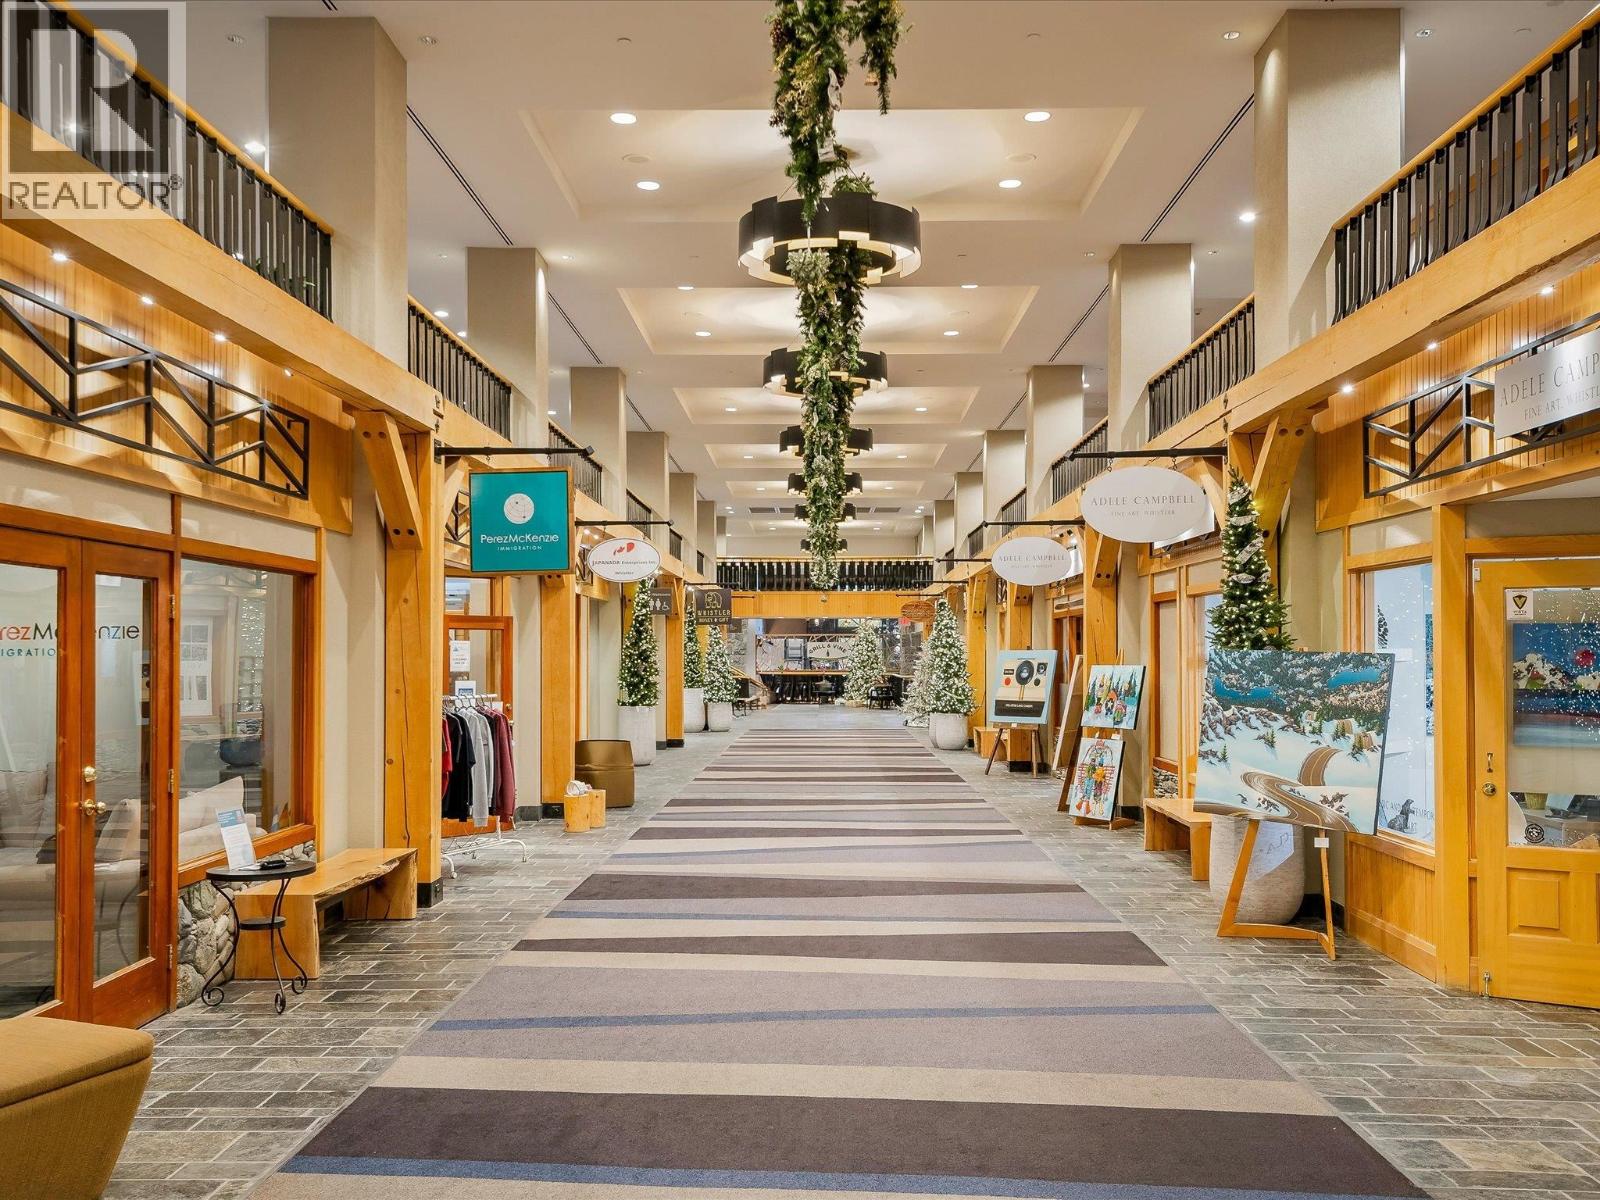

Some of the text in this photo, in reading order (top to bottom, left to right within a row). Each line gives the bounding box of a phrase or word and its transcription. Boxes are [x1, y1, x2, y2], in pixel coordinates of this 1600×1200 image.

[1500, 372, 1545, 407] ADELE
[1524, 406, 1542, 420] FINE
[1090, 495, 1197, 506] ADELE CAMPBELL
[480, 532, 559, 544] PerezMcKenzie
[1, 648, 56, 657] IGRATIO
[809, 644, 825, 654] GRILL
[833, 644, 847, 653] VINE
